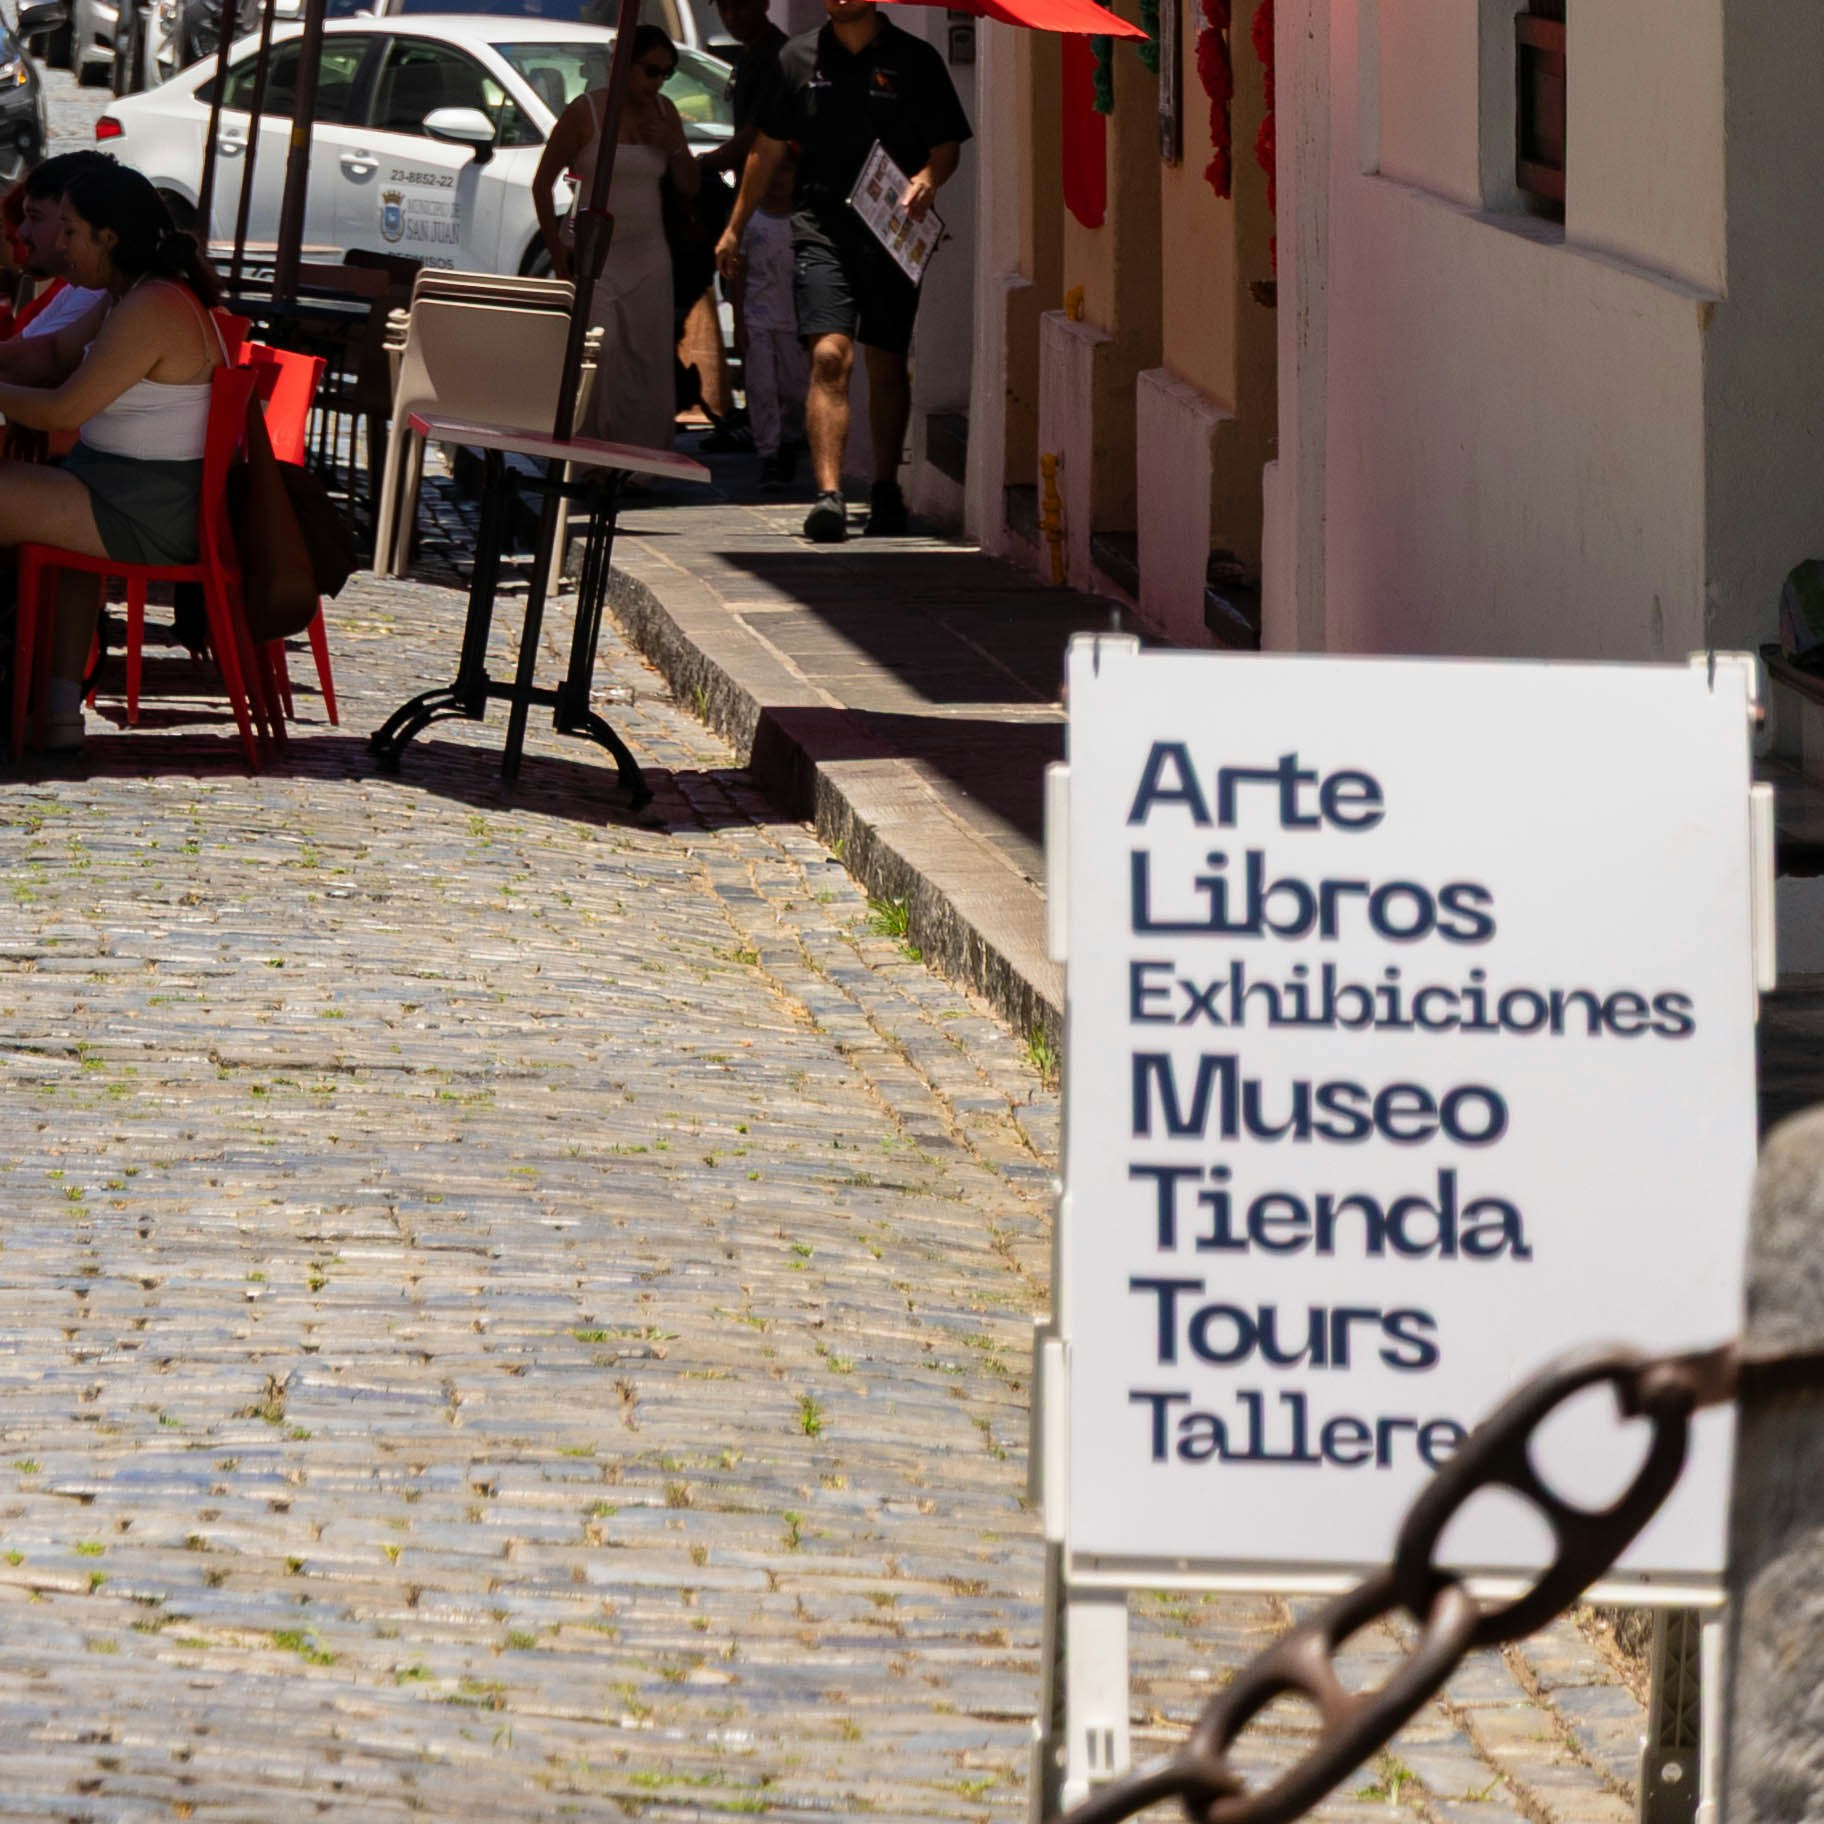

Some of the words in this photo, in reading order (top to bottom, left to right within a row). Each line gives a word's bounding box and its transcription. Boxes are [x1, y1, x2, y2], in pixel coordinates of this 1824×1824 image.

[405, 218, 427, 242] SAN
[431, 220, 461, 245] JUAN
[1127, 741, 1384, 832] Arte
[1129, 849, 1496, 944] Libros
[1128, 960, 1696, 1039] Exhibiciones
[1130, 1051, 1509, 1147] Museo
[1127, 1163, 1534, 1261] Tienda
[1127, 1276, 1440, 1372] Tours
[1127, 1389, 1474, 1472] Tallere
